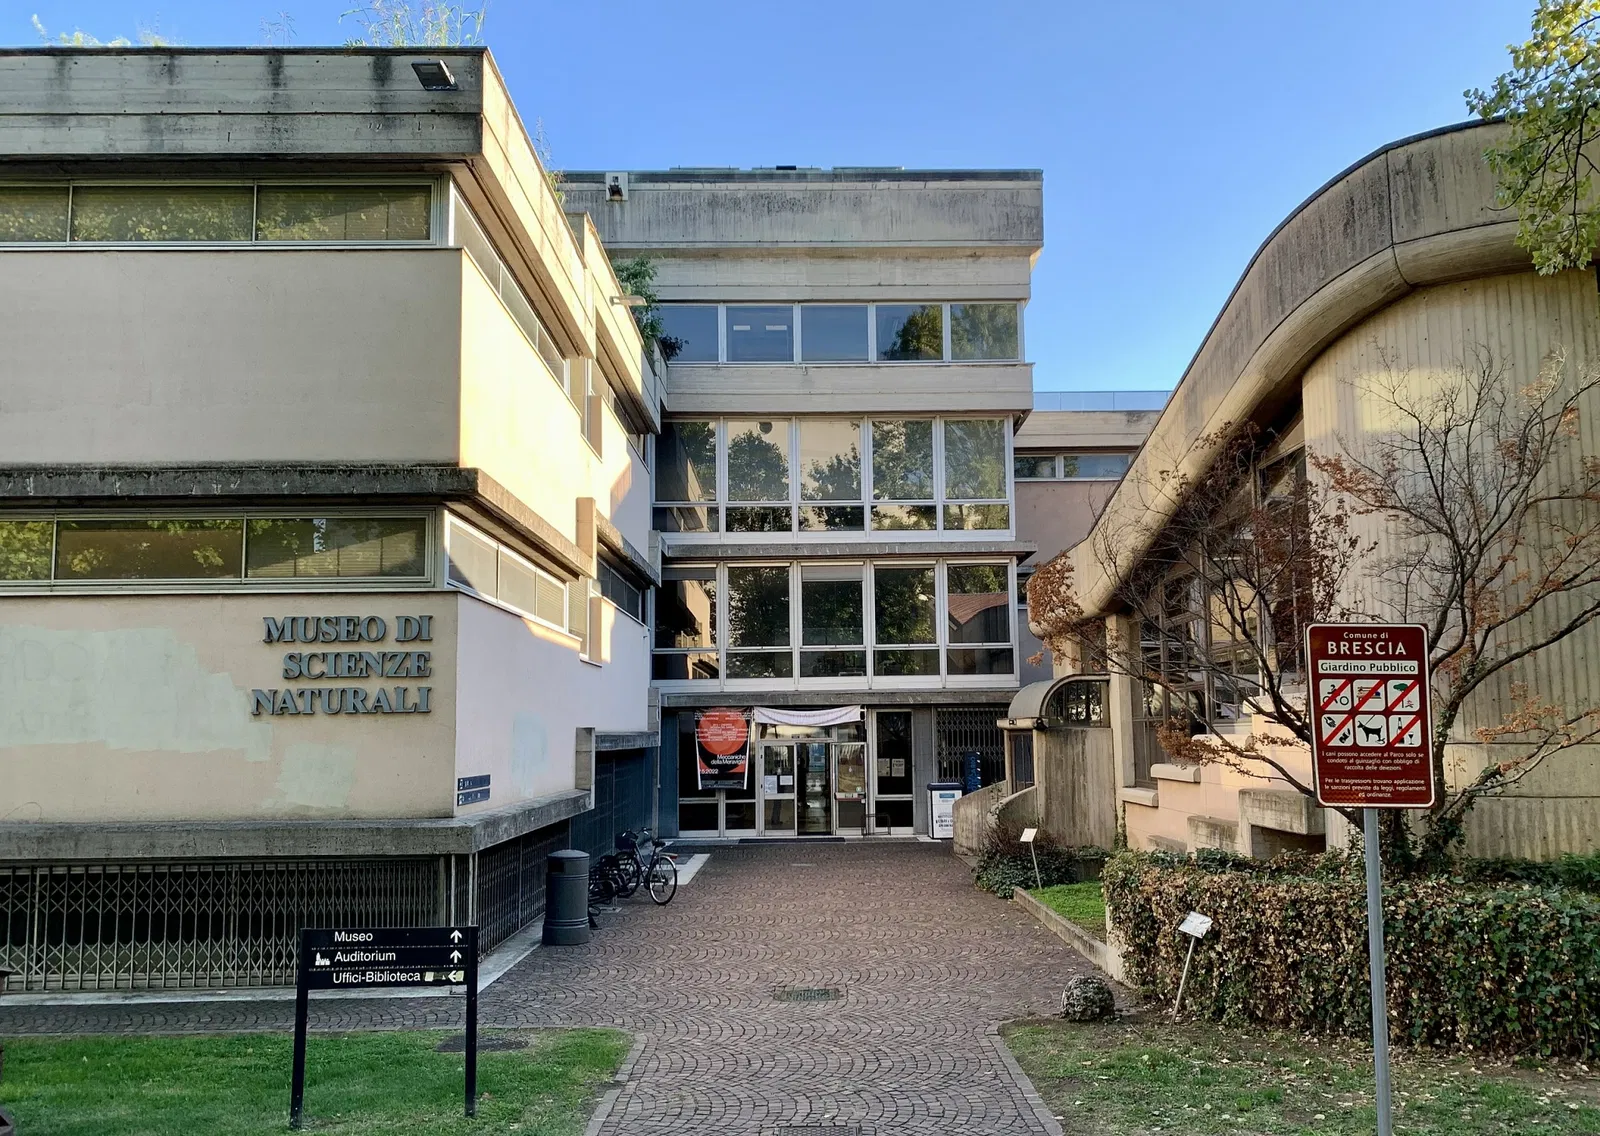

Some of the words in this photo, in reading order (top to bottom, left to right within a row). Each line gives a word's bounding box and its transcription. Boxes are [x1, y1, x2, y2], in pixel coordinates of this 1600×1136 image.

[263, 616, 386, 643] MUSEO
[395, 615, 433, 642] DI
[1327, 641, 1407, 655] BRESCIA
[282, 651, 432, 679] SCIENZE
[1320, 662, 1366, 672] Giardino
[1369, 663, 1416, 672] Pubblico
[251, 686, 432, 715] NATURALI
[334, 931, 373, 942] Museo
[334, 950, 396, 962] Auditorium
[333, 971, 421, 983] Uffici-Biblioteca
